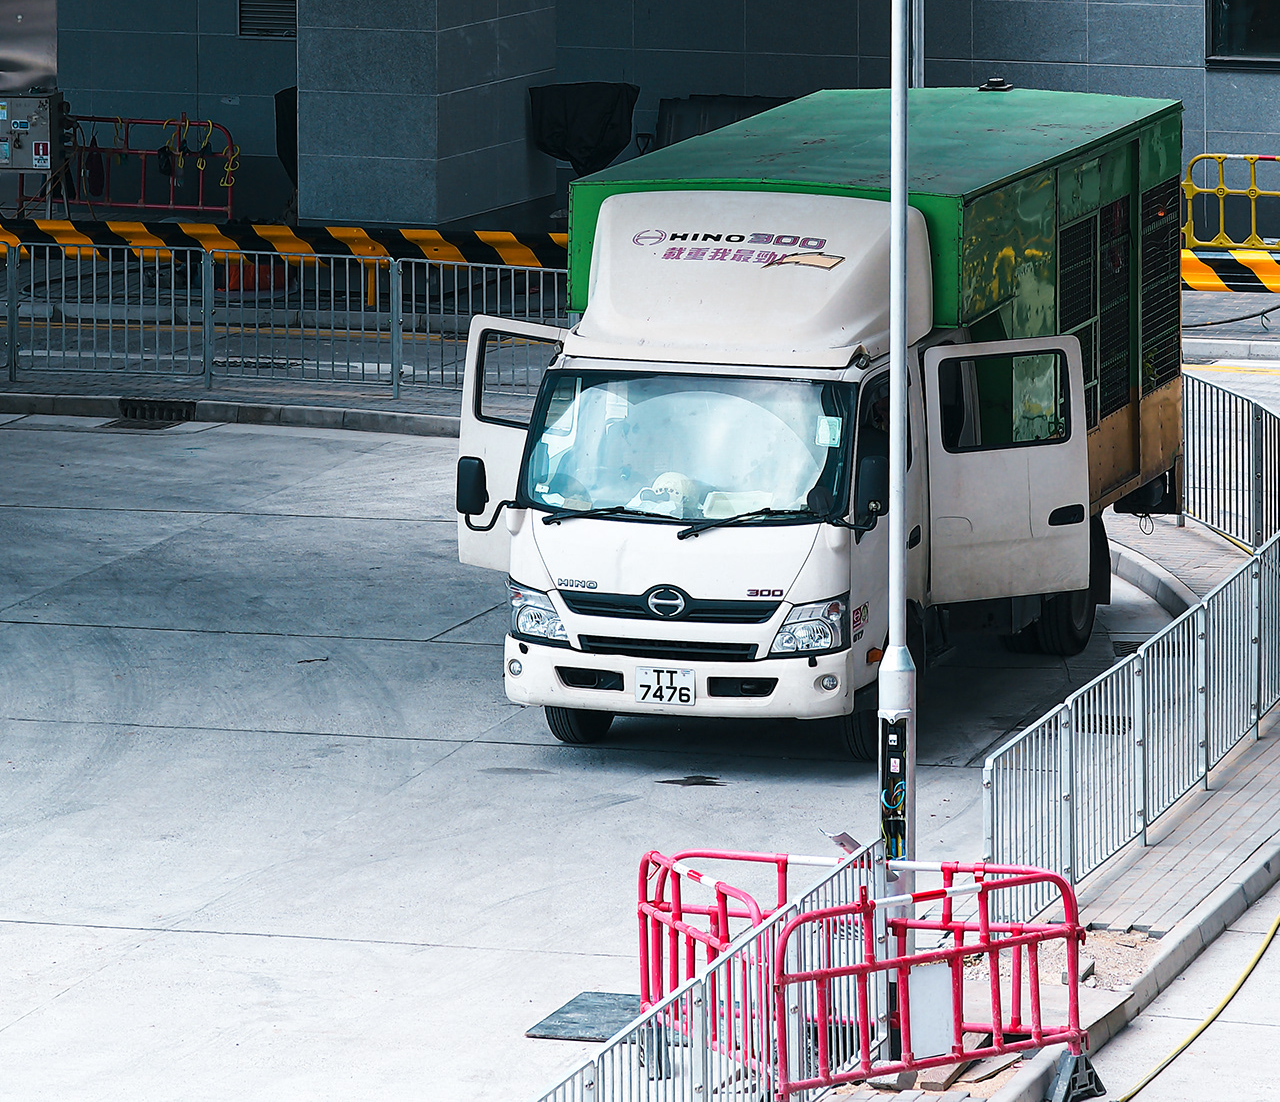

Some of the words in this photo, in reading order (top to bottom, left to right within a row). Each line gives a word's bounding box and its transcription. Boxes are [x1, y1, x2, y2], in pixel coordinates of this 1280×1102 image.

[669, 232, 746, 243] HINO
[747, 232, 827, 250] 300
[557, 577, 598, 590] HINO
[746, 588, 784, 598] 300
[652, 669, 679, 687] TT
[639, 683, 691, 704] 7476
